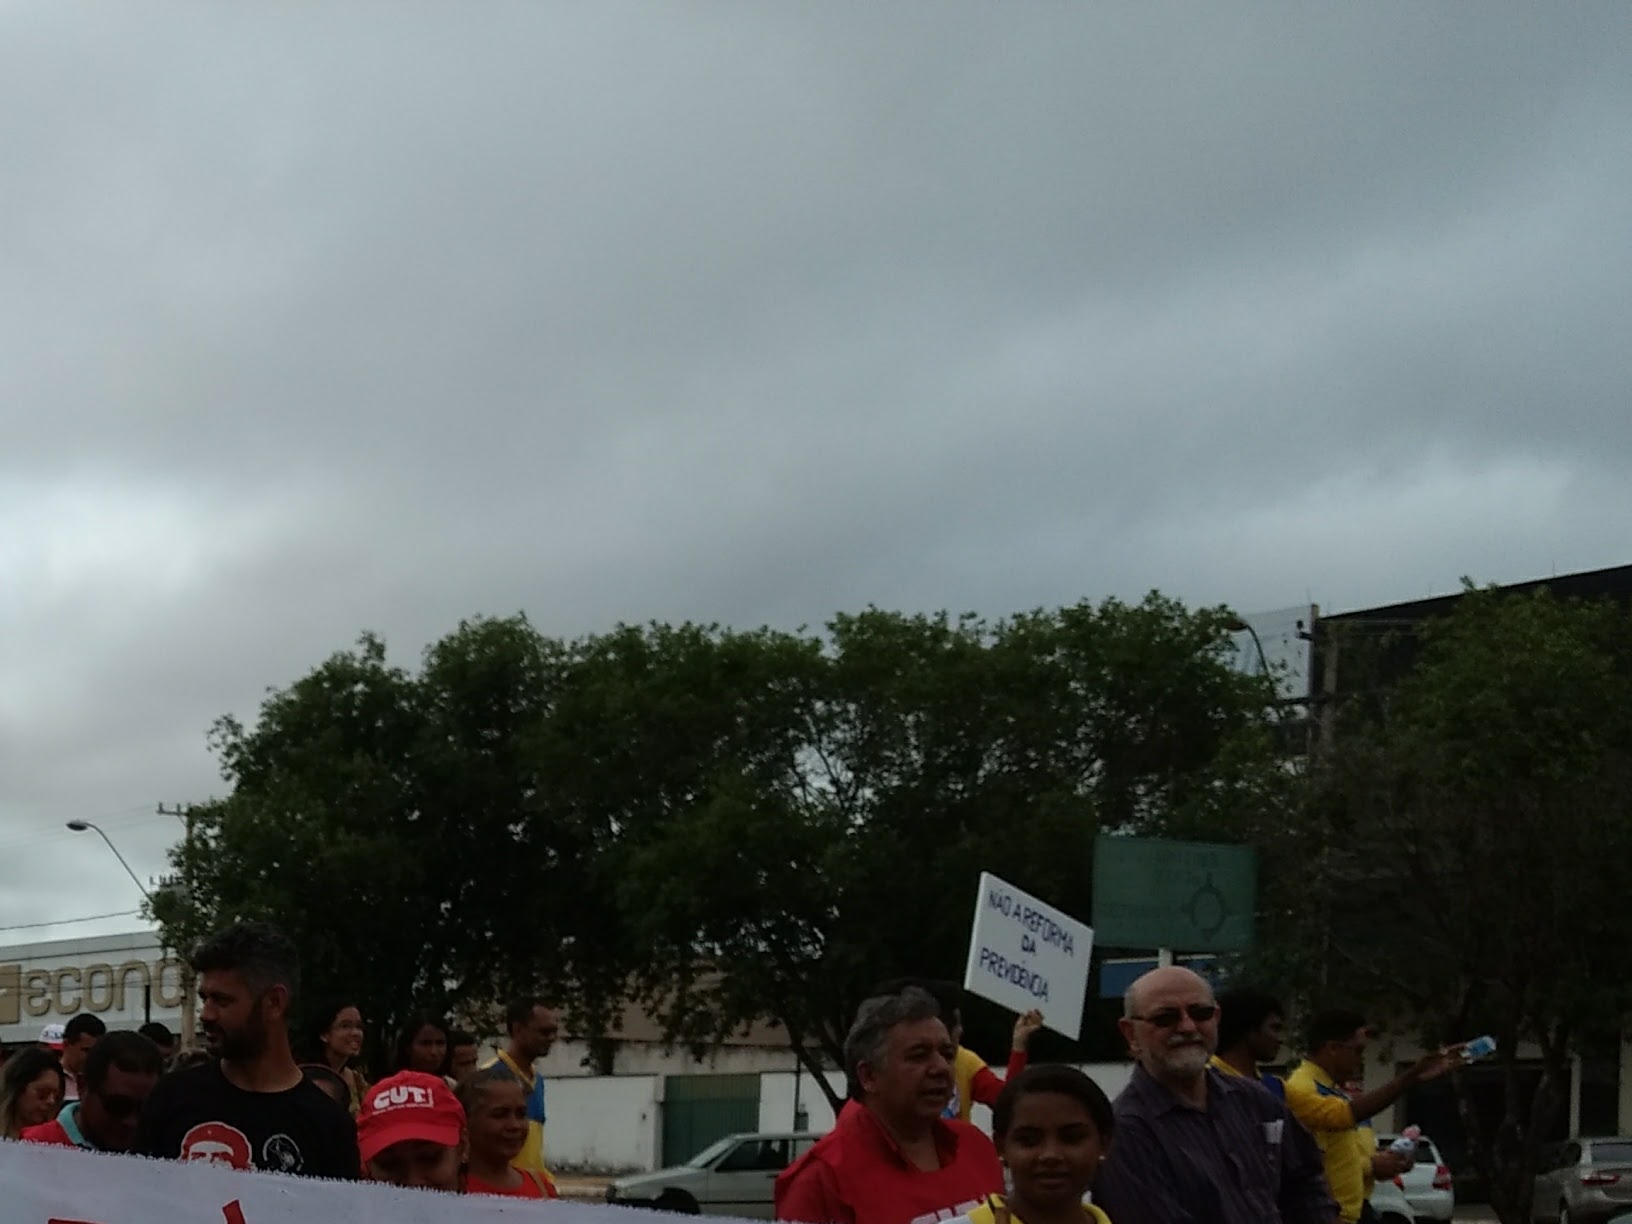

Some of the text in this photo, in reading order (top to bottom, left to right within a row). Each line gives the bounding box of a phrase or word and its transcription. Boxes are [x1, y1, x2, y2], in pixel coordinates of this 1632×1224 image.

[1023, 907, 1074, 957] REFORMA
[1021, 934, 1037, 956] DA
[374, 1086, 426, 1109] CUT
